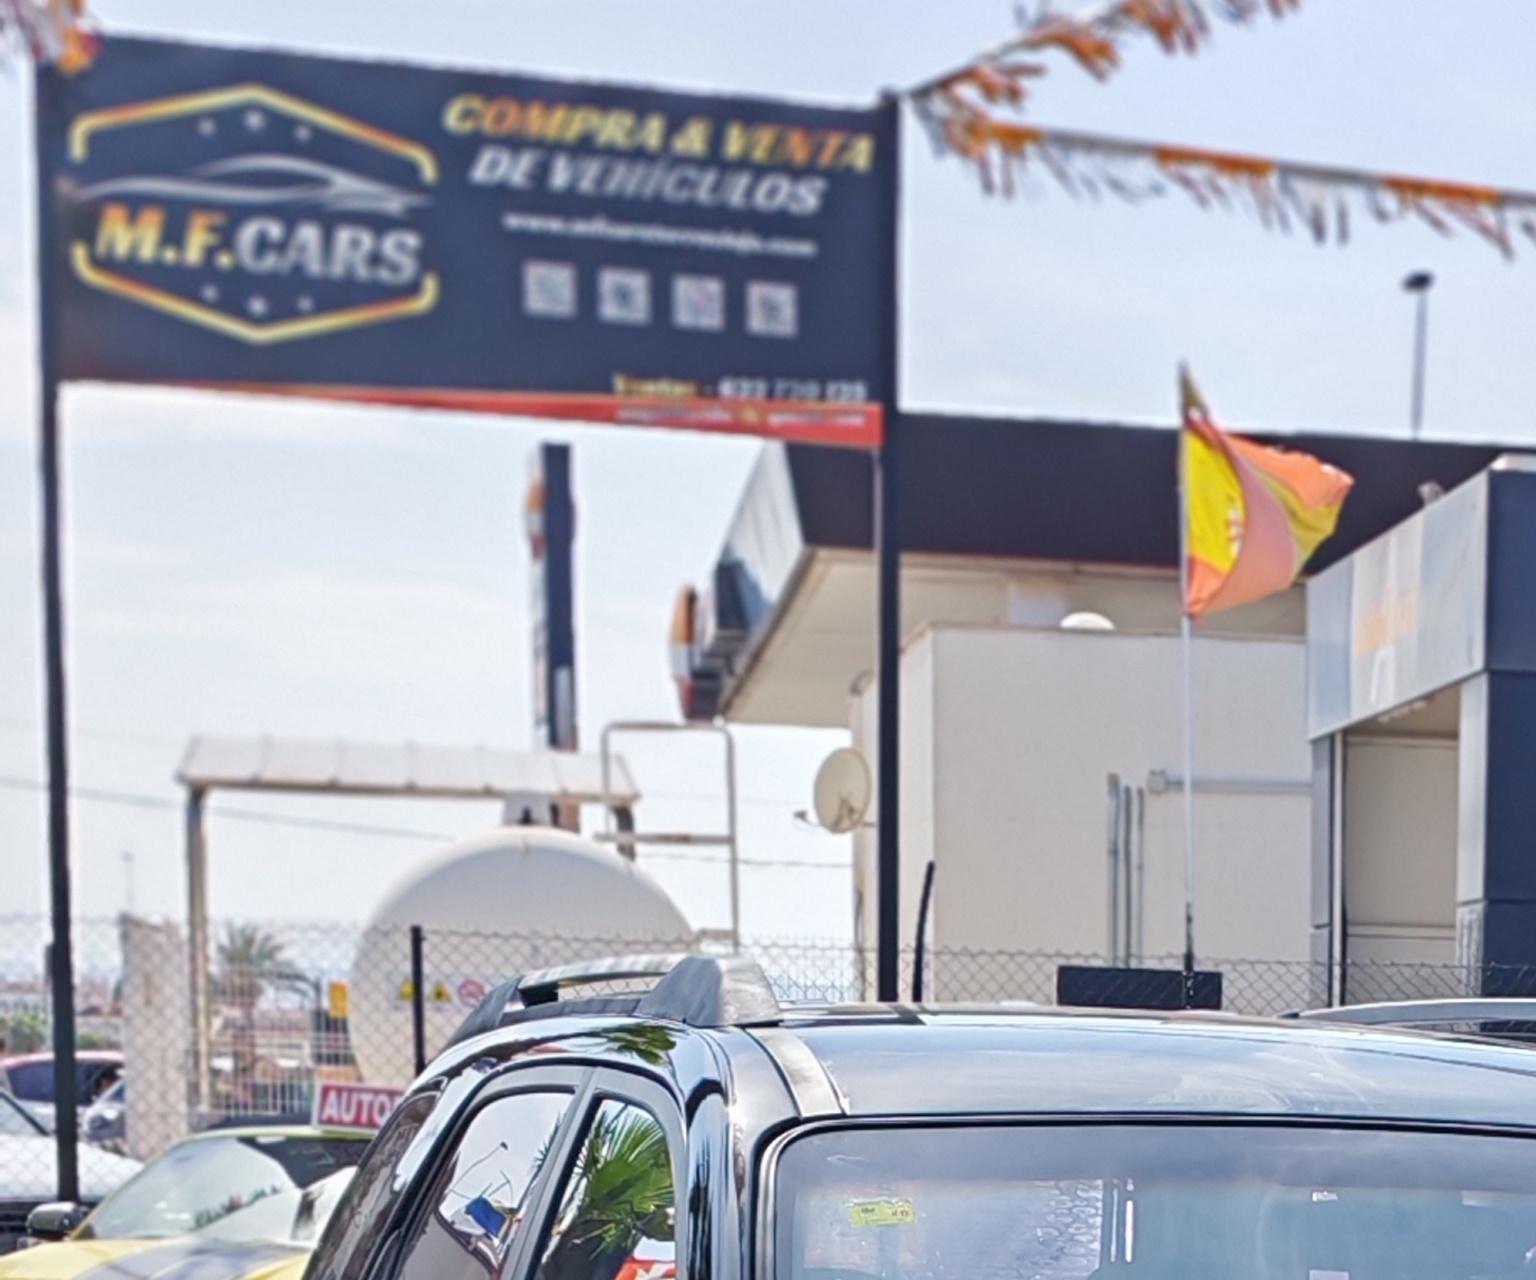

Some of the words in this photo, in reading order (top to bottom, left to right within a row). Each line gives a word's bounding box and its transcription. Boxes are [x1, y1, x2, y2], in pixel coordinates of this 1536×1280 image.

[442, 92, 668, 154] COMPRA
[671, 115, 714, 158] &
[722, 119, 877, 175] VENTA
[468, 145, 546, 191] DE
[546, 148, 829, 217] VEHÍCULOS
[320, 1088, 404, 1127] AUTO
